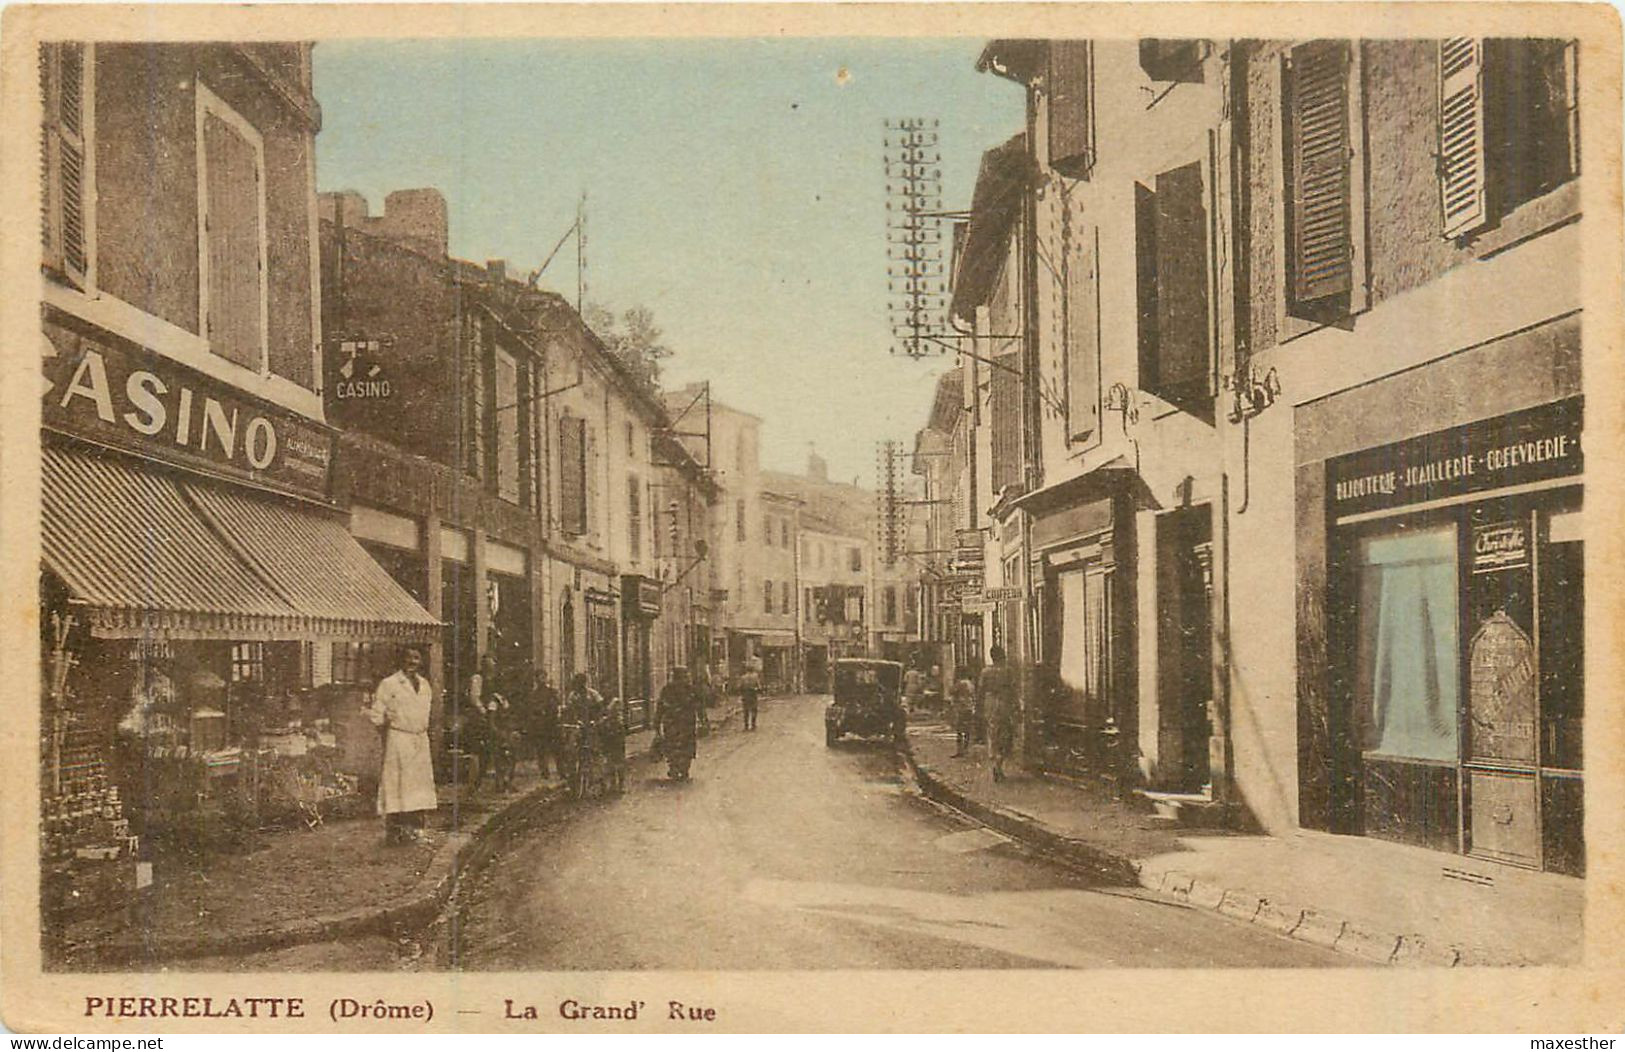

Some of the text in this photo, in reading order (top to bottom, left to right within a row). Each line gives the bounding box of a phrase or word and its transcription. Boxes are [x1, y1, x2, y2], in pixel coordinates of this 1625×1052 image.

[41, 331, 276, 469] ASINO
[336, 380, 391, 399] CASINO
[1336, 435, 1568, 500] BIJOUTERIE JOAILLERIE ORFEVRERIE
